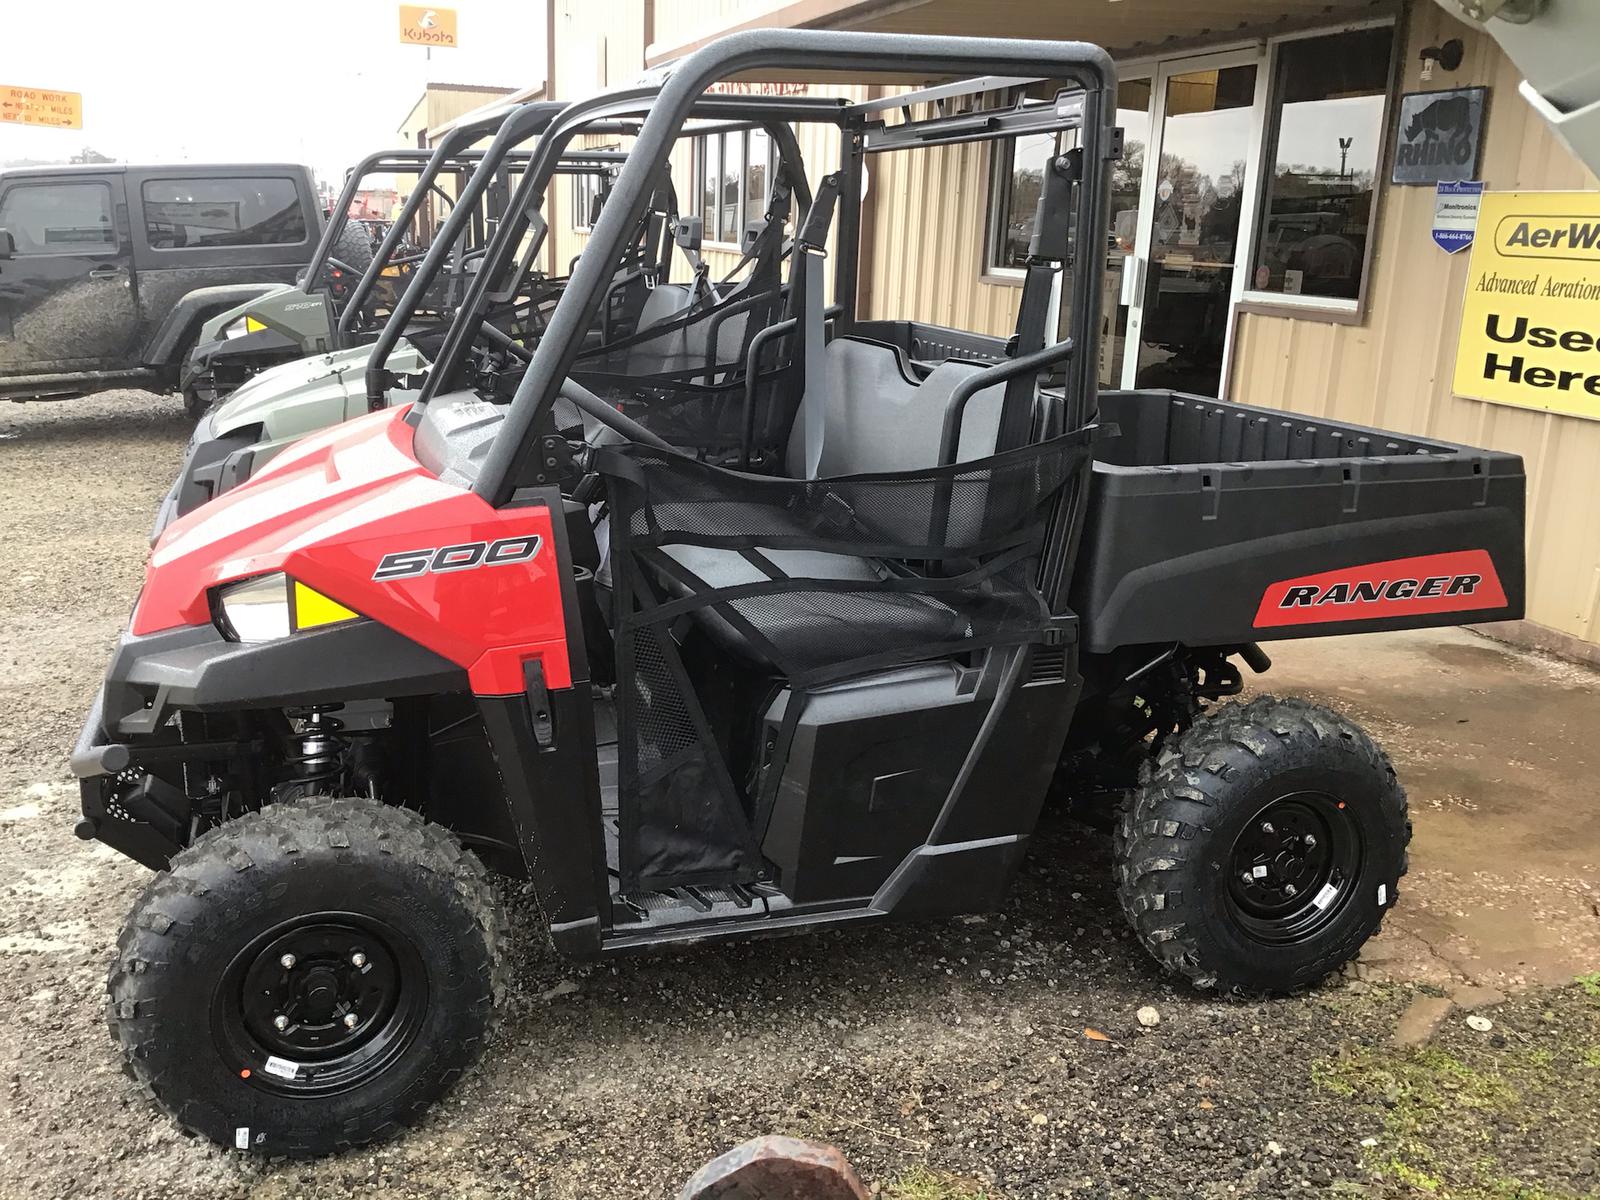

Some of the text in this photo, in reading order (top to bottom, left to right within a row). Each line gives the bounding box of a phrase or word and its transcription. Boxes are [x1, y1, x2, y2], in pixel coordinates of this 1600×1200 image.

[403, 28, 454, 43] Kubota
[10, 89, 68, 103] ROAD WORK
[50, 105, 73, 115] MILES
[1397, 142, 1471, 165] RHINO
[1505, 222, 1600, 250] AerW
[1475, 271, 1600, 301] Advanced Aeration
[1485, 313, 1600, 352] Use
[371, 534, 543, 583] 500
[1278, 574, 1483, 609] RANGER
